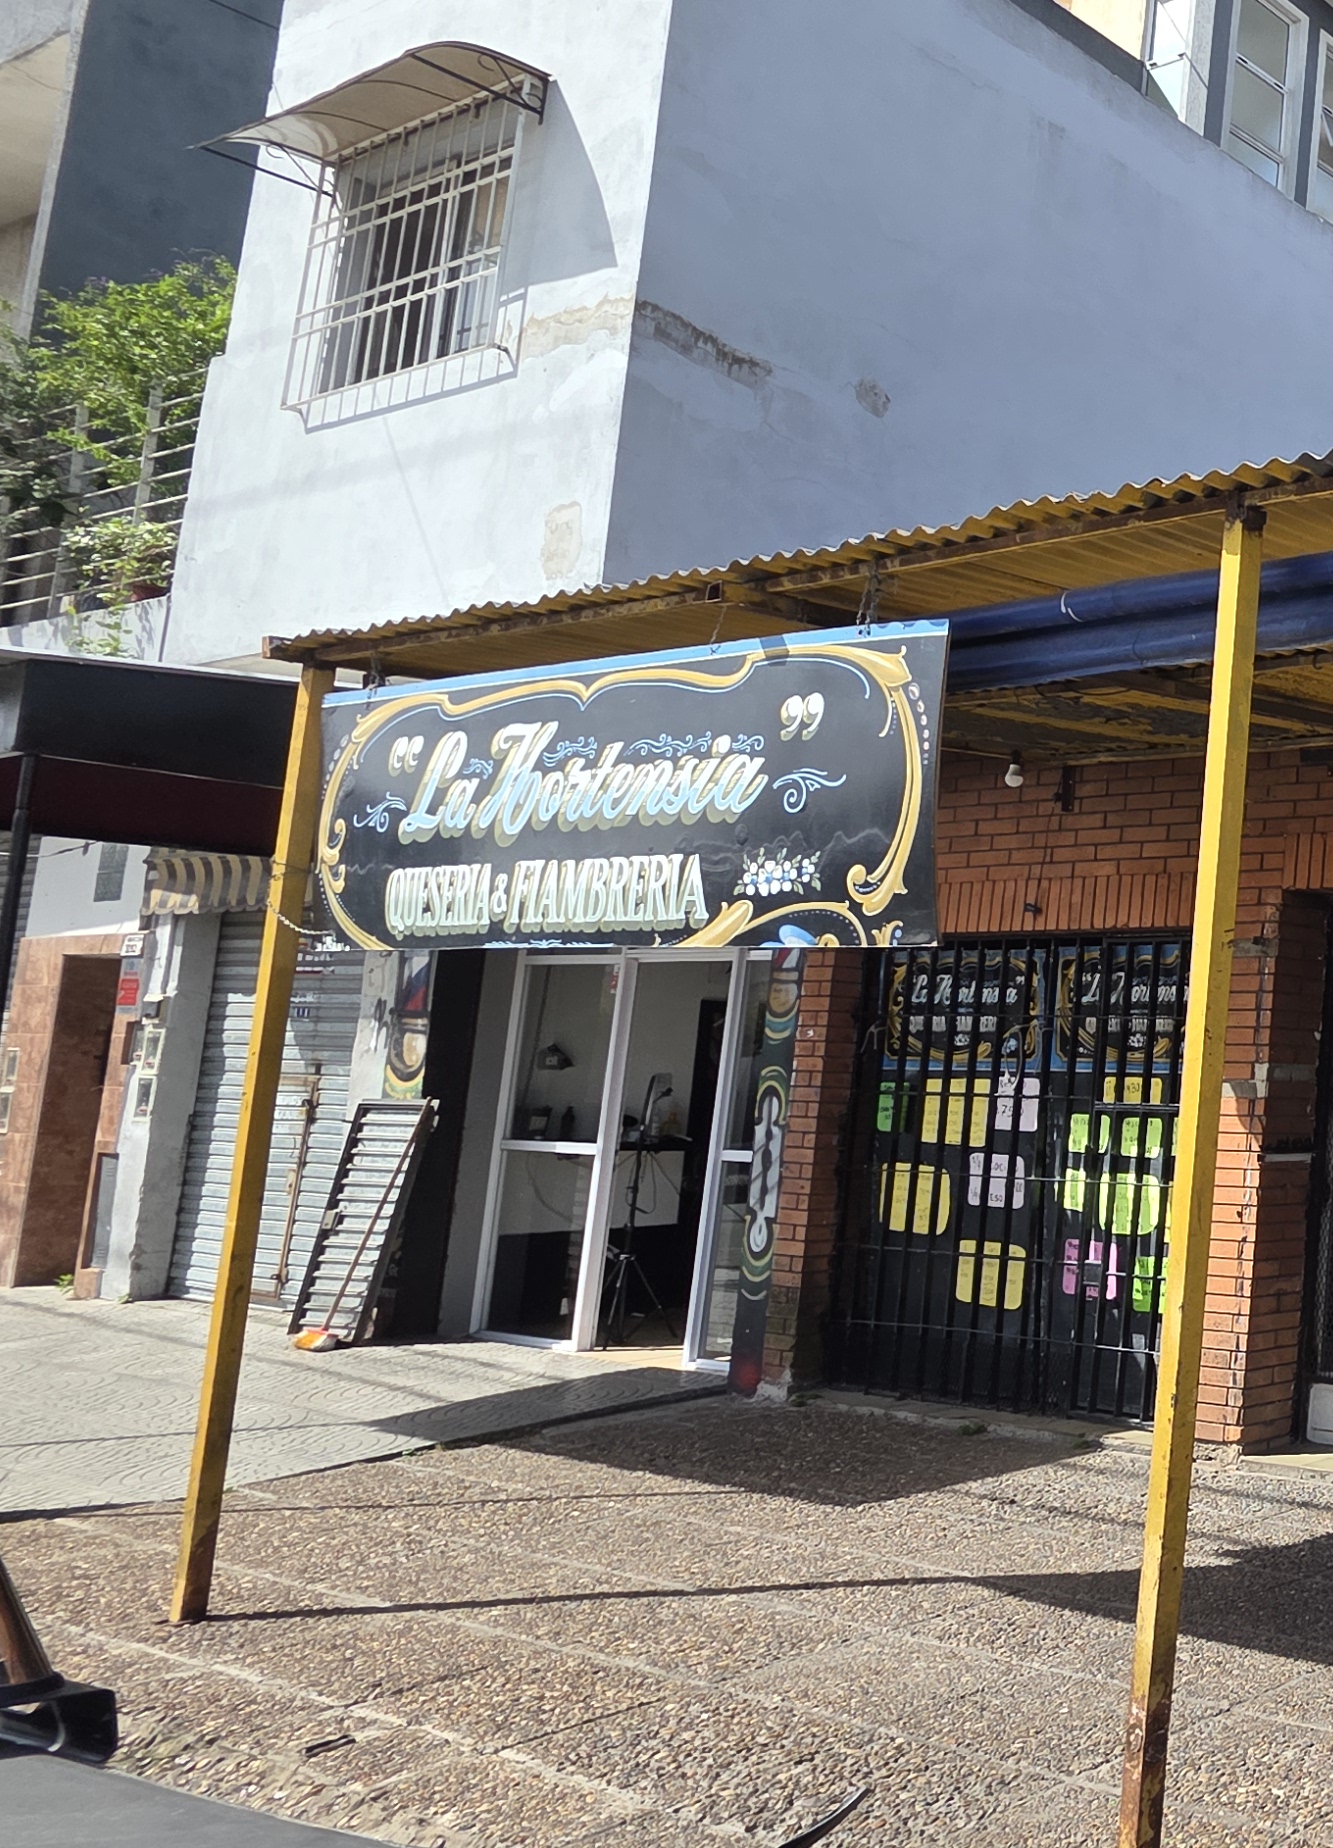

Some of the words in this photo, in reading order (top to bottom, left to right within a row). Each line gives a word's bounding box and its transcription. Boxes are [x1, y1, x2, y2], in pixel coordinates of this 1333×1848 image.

[386, 863, 492, 940] QUESERIA
[489, 873, 508, 922] &
[504, 853, 709, 933] FIAMBRERIA
